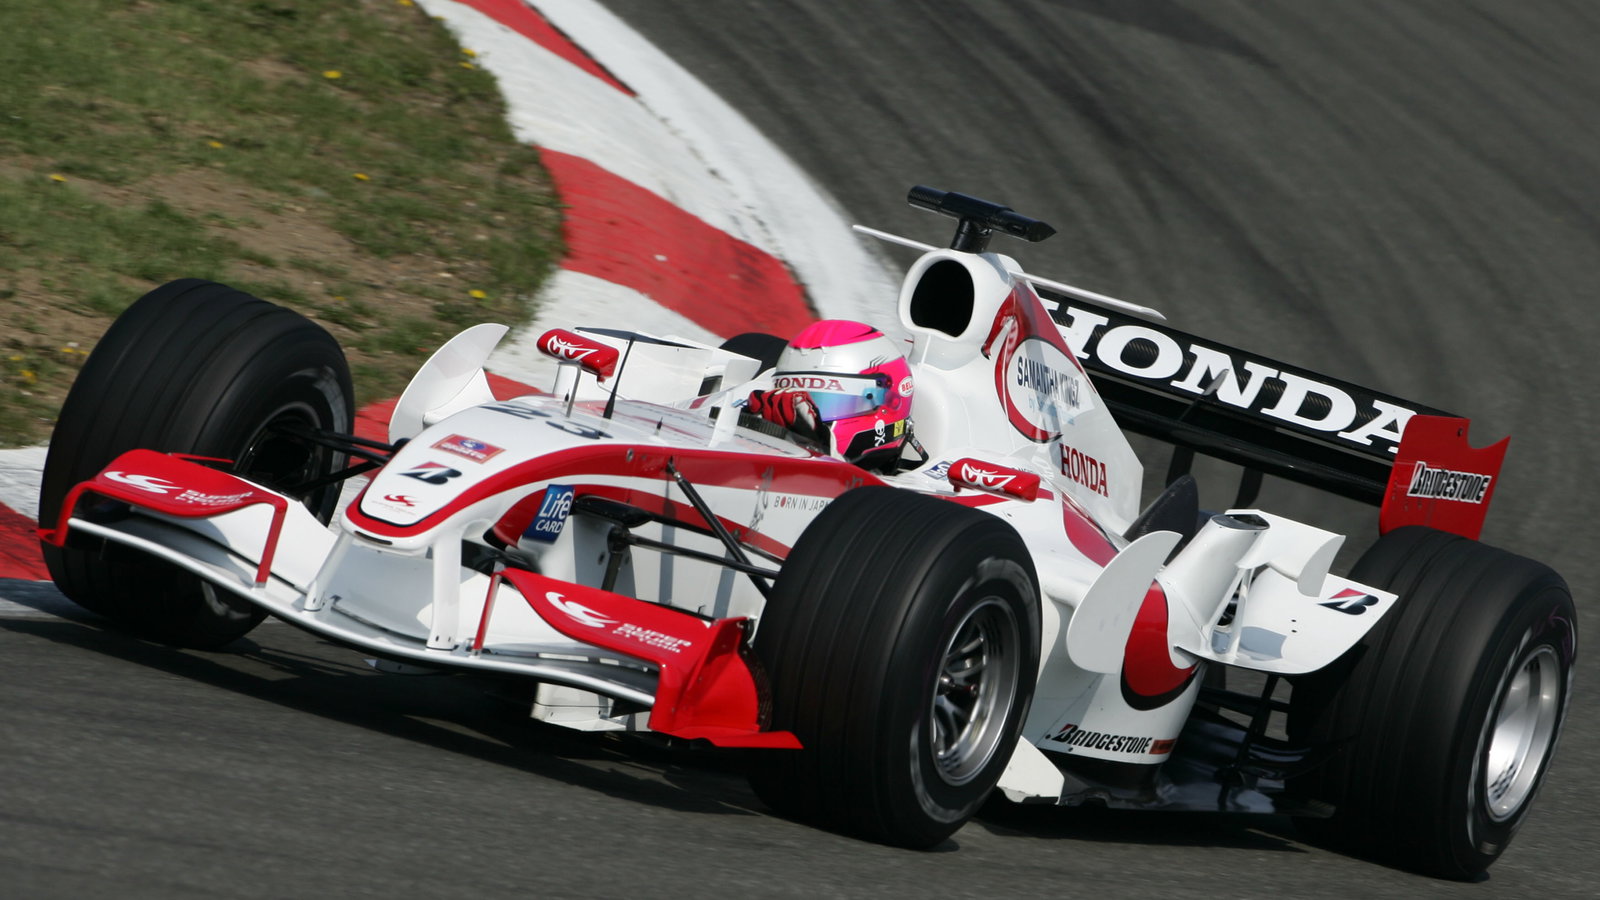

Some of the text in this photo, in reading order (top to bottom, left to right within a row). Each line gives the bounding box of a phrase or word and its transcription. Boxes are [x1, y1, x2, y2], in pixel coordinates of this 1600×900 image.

[1017, 356, 1058, 396] SAMANTHA
[1039, 297, 1418, 454] HONDA
[1059, 443, 1108, 498] HONDA
[1407, 461, 1491, 504] BRIDGESTONE
[539, 491, 573, 520] Life
[774, 496, 829, 511] BORN IN JAP
[535, 519, 564, 533] CARD
[1051, 723, 1153, 754] BRIDGESTONE
